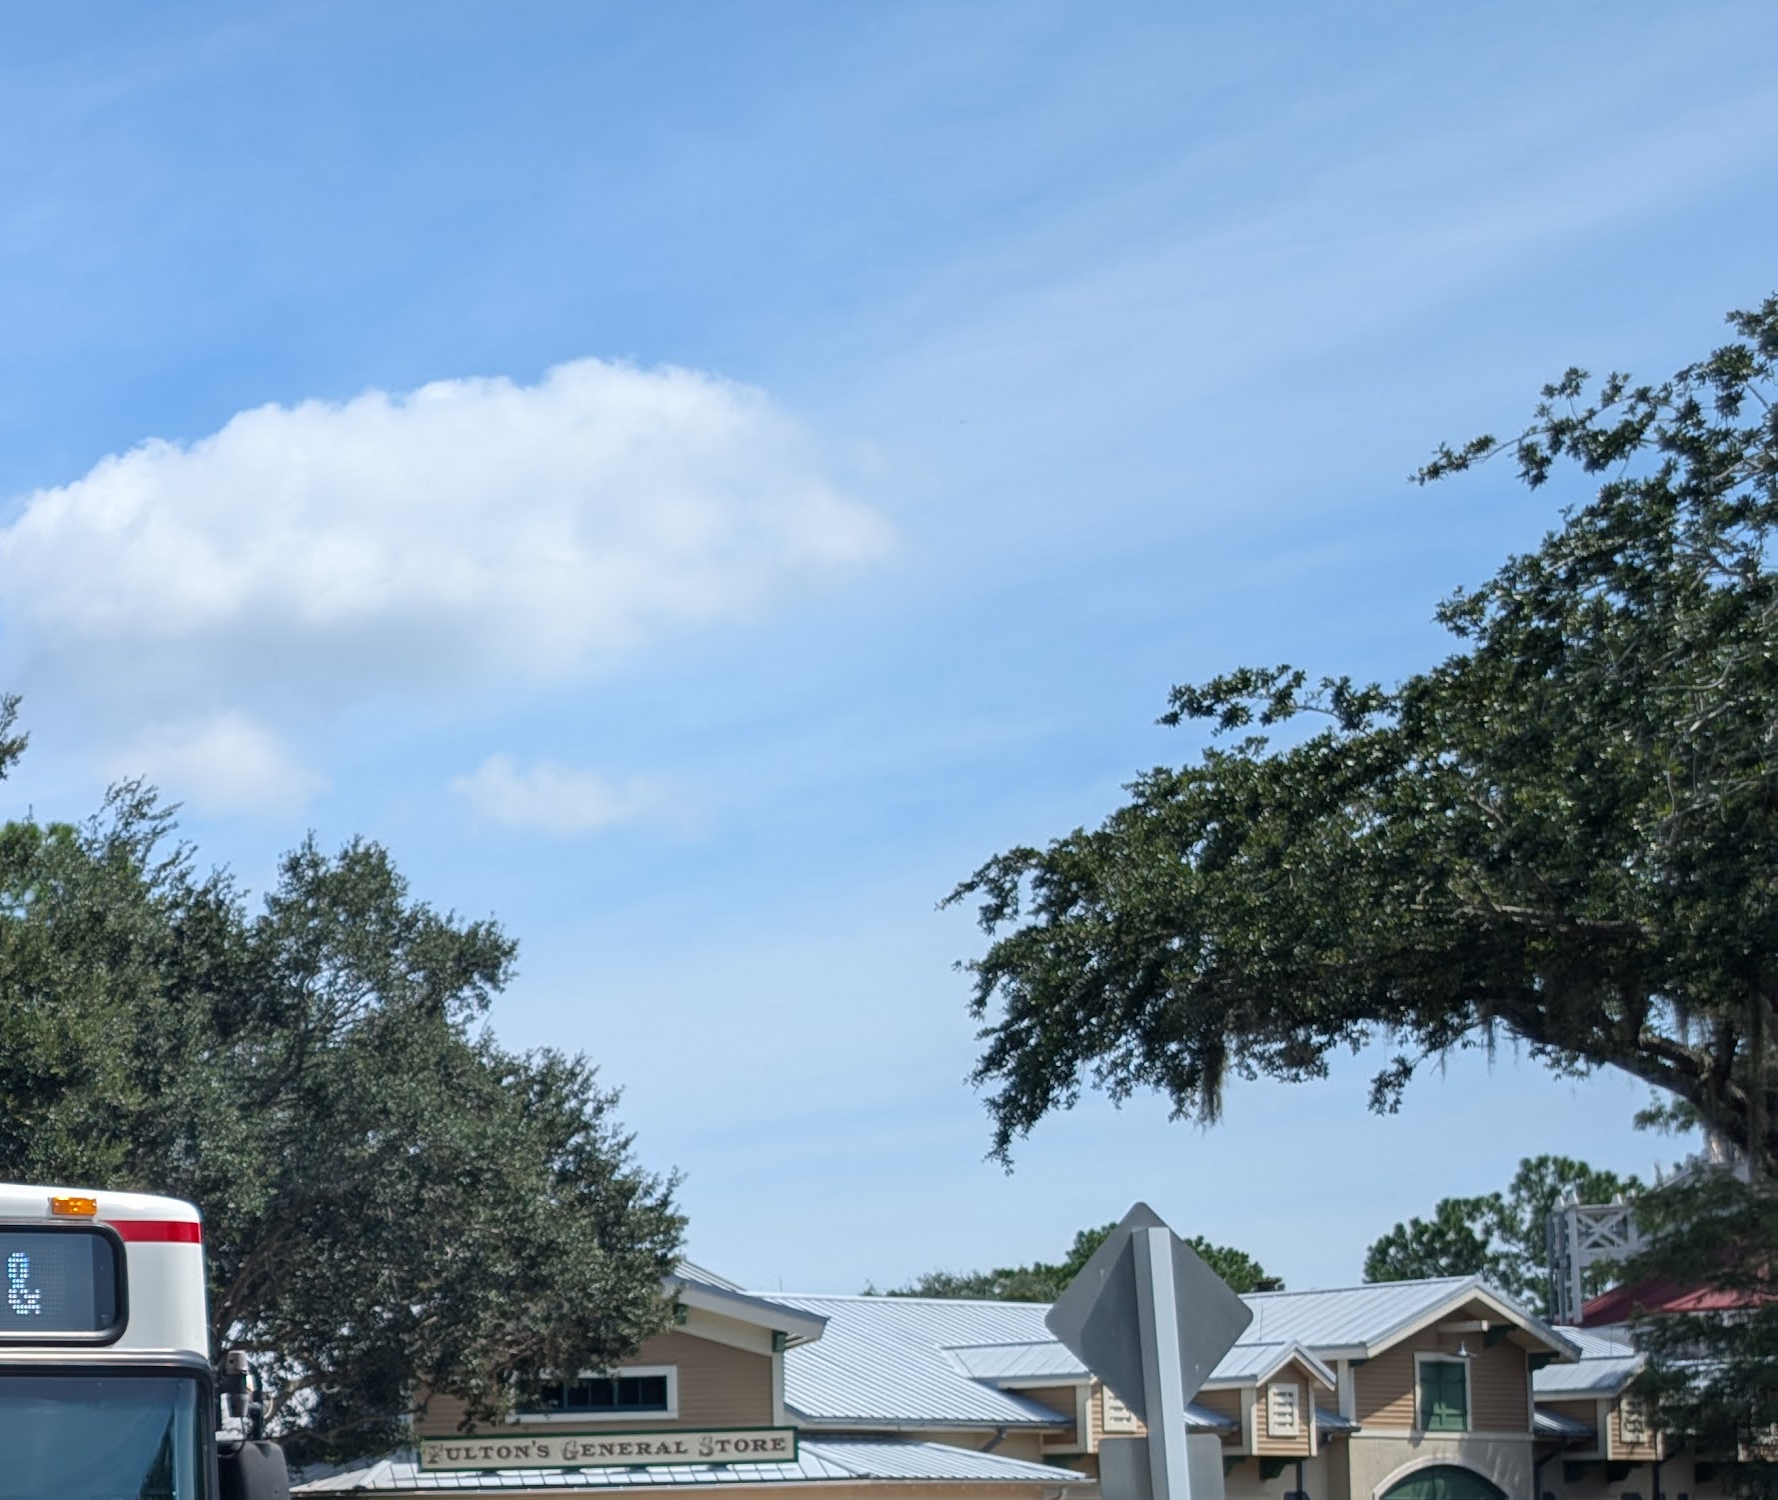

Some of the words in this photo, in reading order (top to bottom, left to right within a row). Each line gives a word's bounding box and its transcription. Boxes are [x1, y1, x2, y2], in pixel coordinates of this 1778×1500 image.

[7, 1252, 42, 1315] &
[425, 1440, 551, 1465] FULTON'S
[560, 1438, 689, 1462] GENERAL
[697, 1433, 787, 1459] STORE
